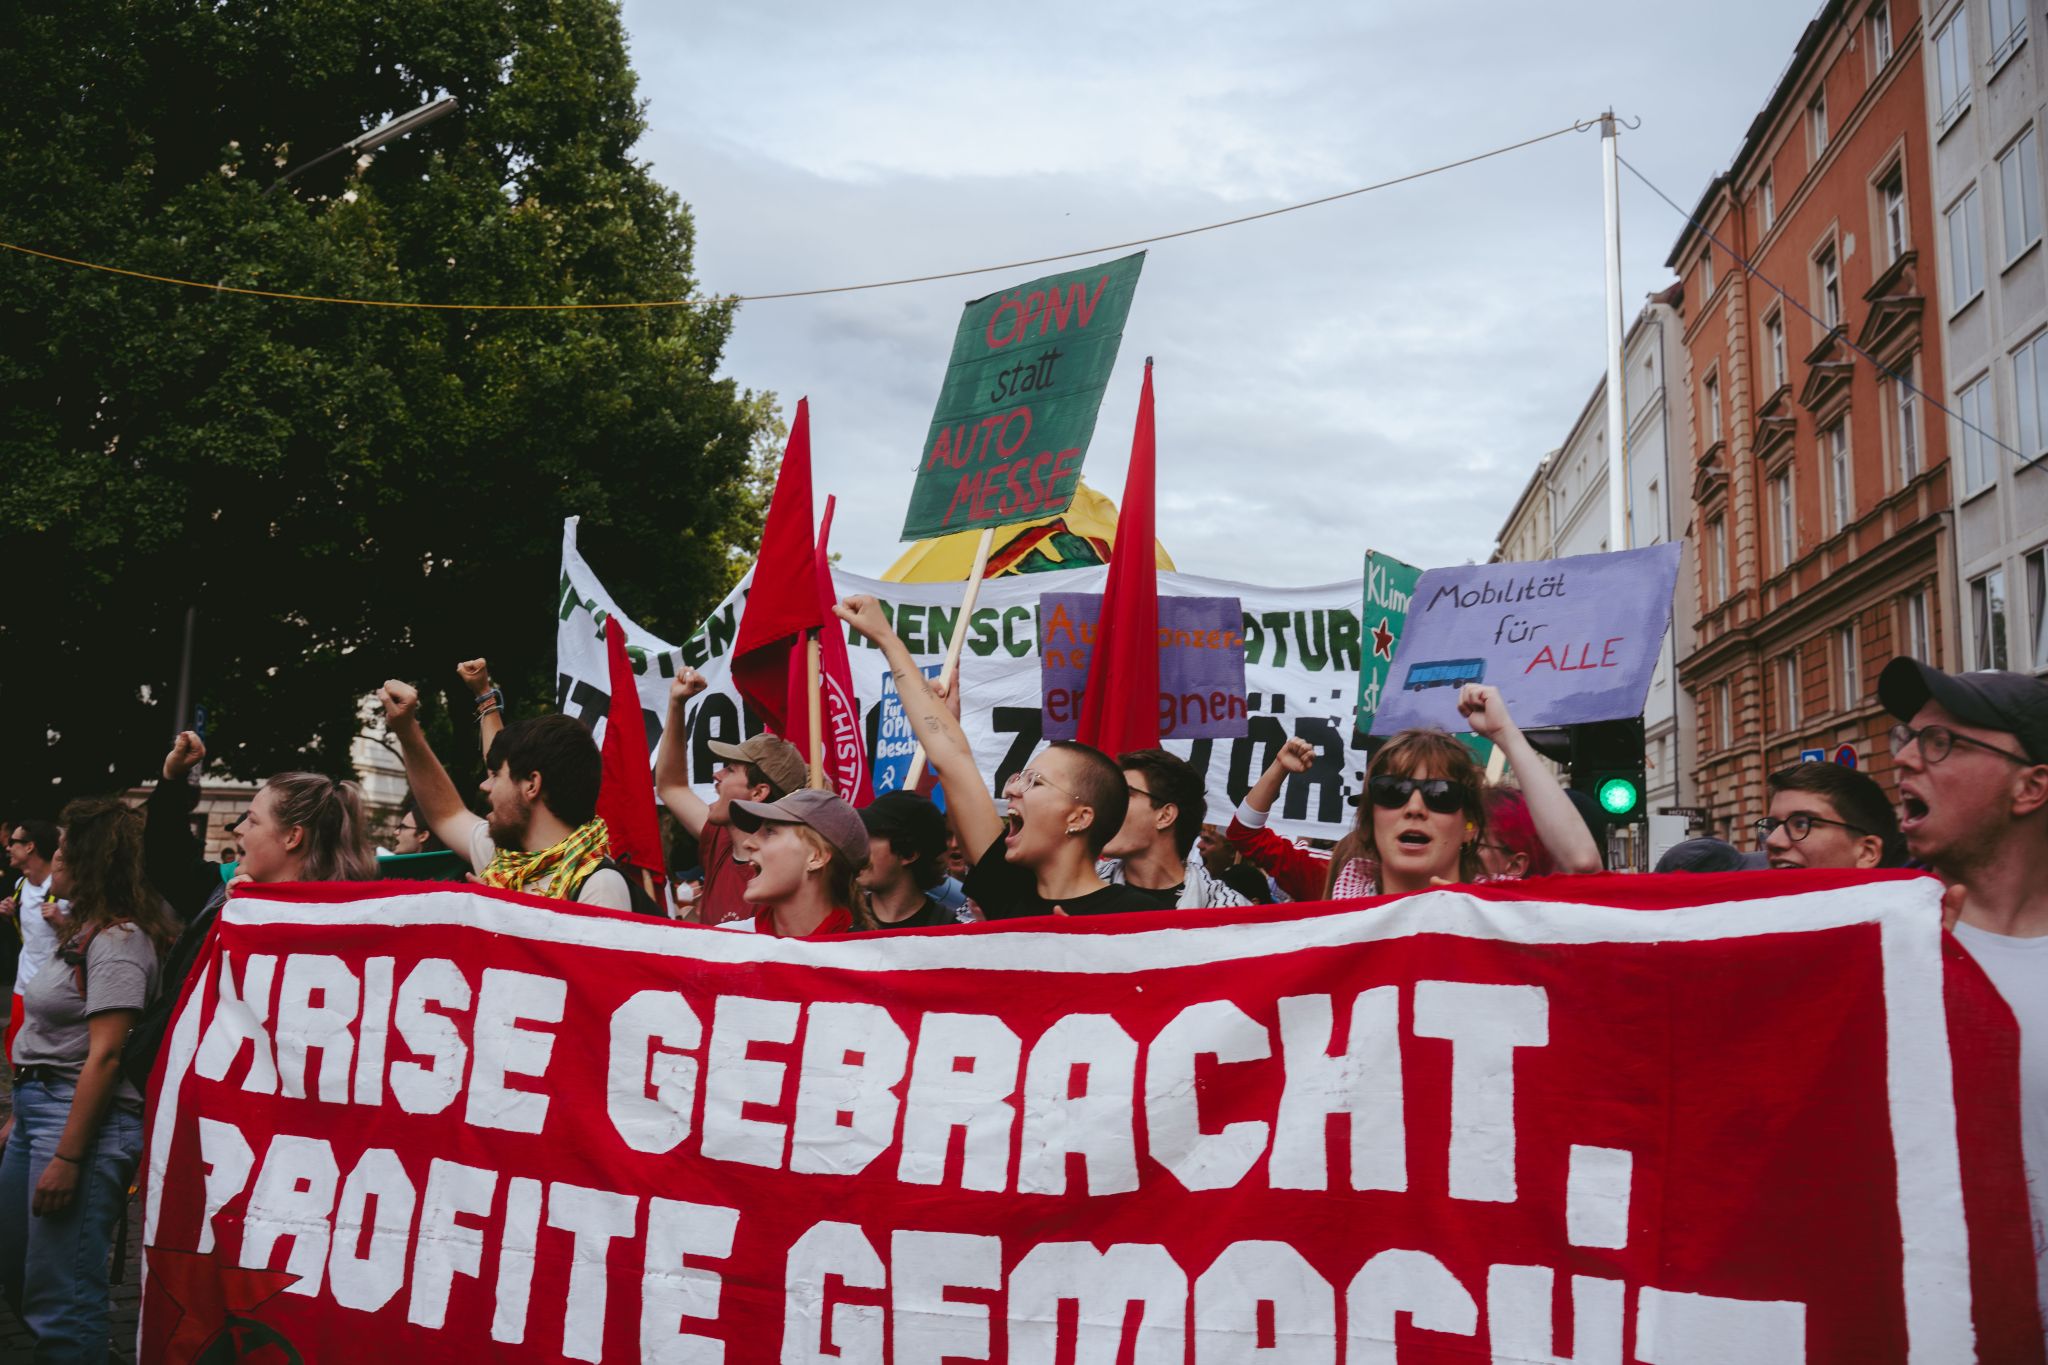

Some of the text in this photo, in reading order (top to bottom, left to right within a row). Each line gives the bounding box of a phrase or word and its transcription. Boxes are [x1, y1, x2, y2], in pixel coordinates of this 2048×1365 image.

[986, 275, 1110, 349] ÖPNV
[990, 347, 1064, 403] statt
[926, 406, 1034, 472] AUTO
[942, 447, 1081, 527] MESSE
[1425, 573, 1567, 612] Mobilität
[848, 599, 1040, 658] ENSC
[1242, 609, 1363, 671] ATUR
[1494, 613, 1549, 645] für
[1523, 637, 1624, 674] ALLE
[877, 736, 918, 759] Besch
[882, 716, 913, 738] ÖPN
[195, 949, 567, 1134] KRISE
[197, 1116, 741, 1365] PROFITE
